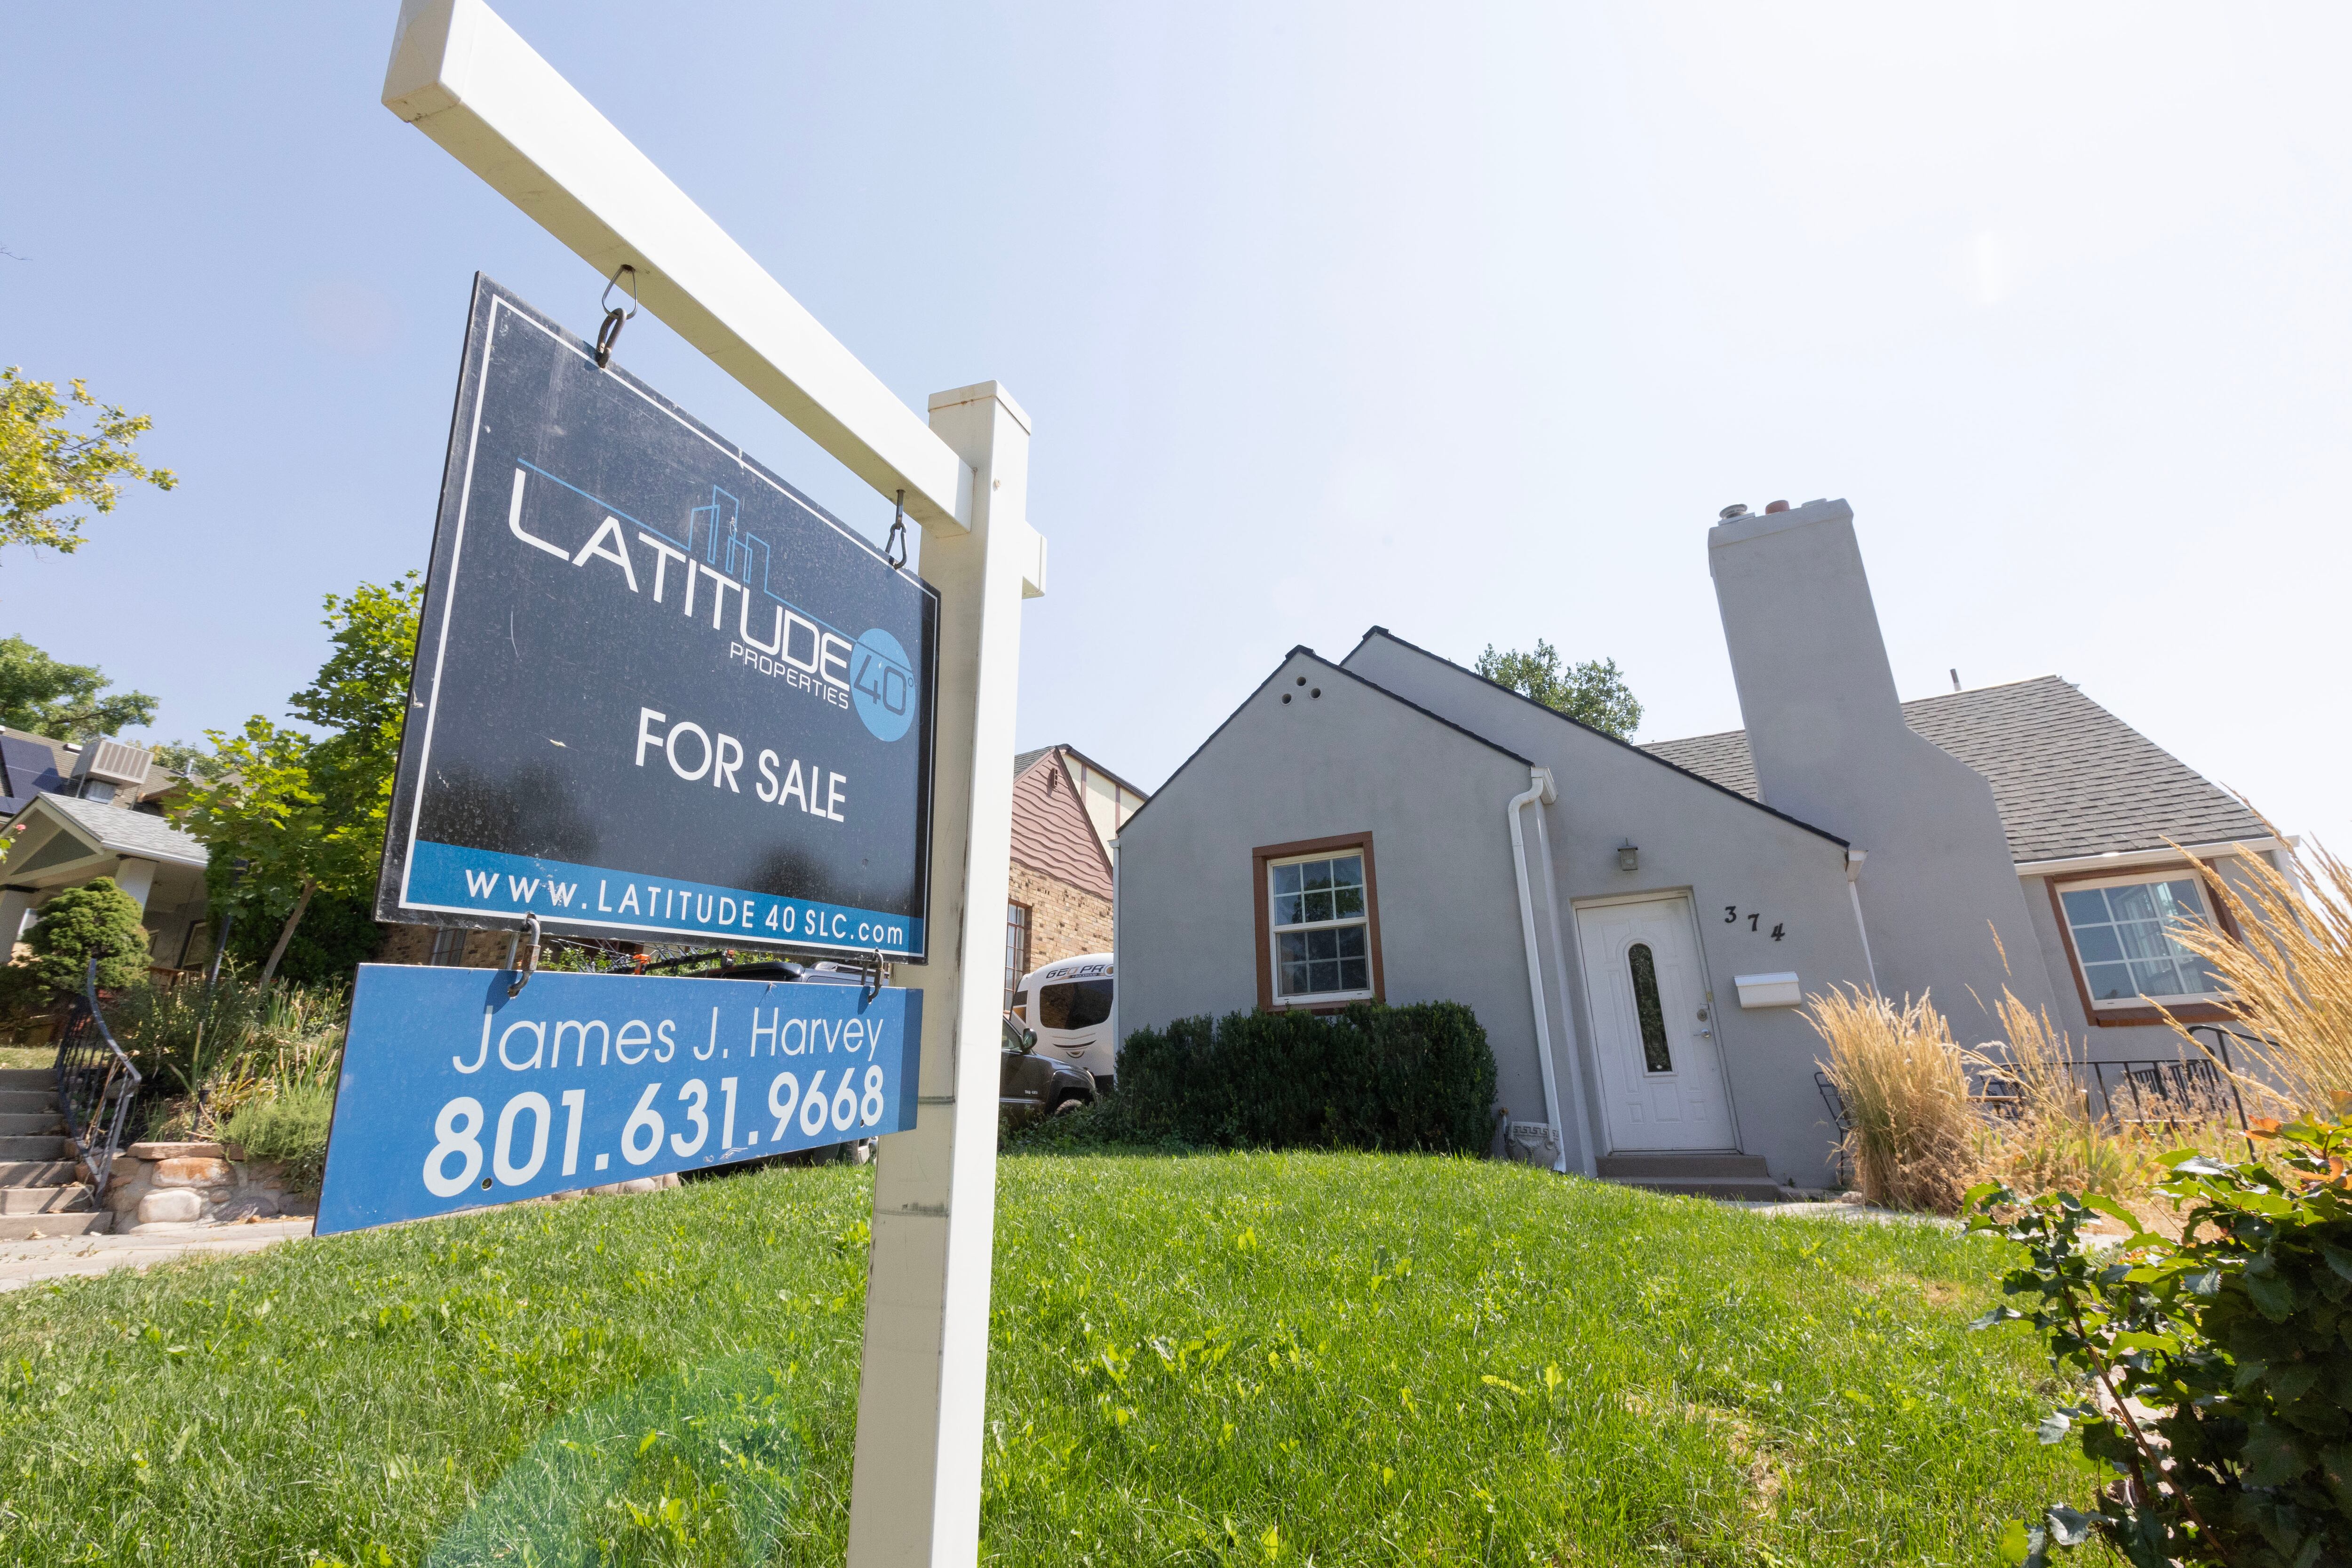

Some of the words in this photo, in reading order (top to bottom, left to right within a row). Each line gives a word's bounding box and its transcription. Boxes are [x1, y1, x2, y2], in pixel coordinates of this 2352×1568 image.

[509, 468, 852, 692] LATITUDE
[731, 642, 849, 710] PROPERTIES
[636, 707, 744, 793] FOR
[756, 749, 846, 823] SALE
[805, 909, 903, 945] SLC.com
[1724, 906, 1785, 941] 374
[1046, 967, 1080, 979] GEO
[453, 1006, 675, 1074] James
[693, 1007, 728, 1061] J.
[750, 1006, 883, 1062] Harvey
[422, 1065, 884, 1198] 801.631.9668
